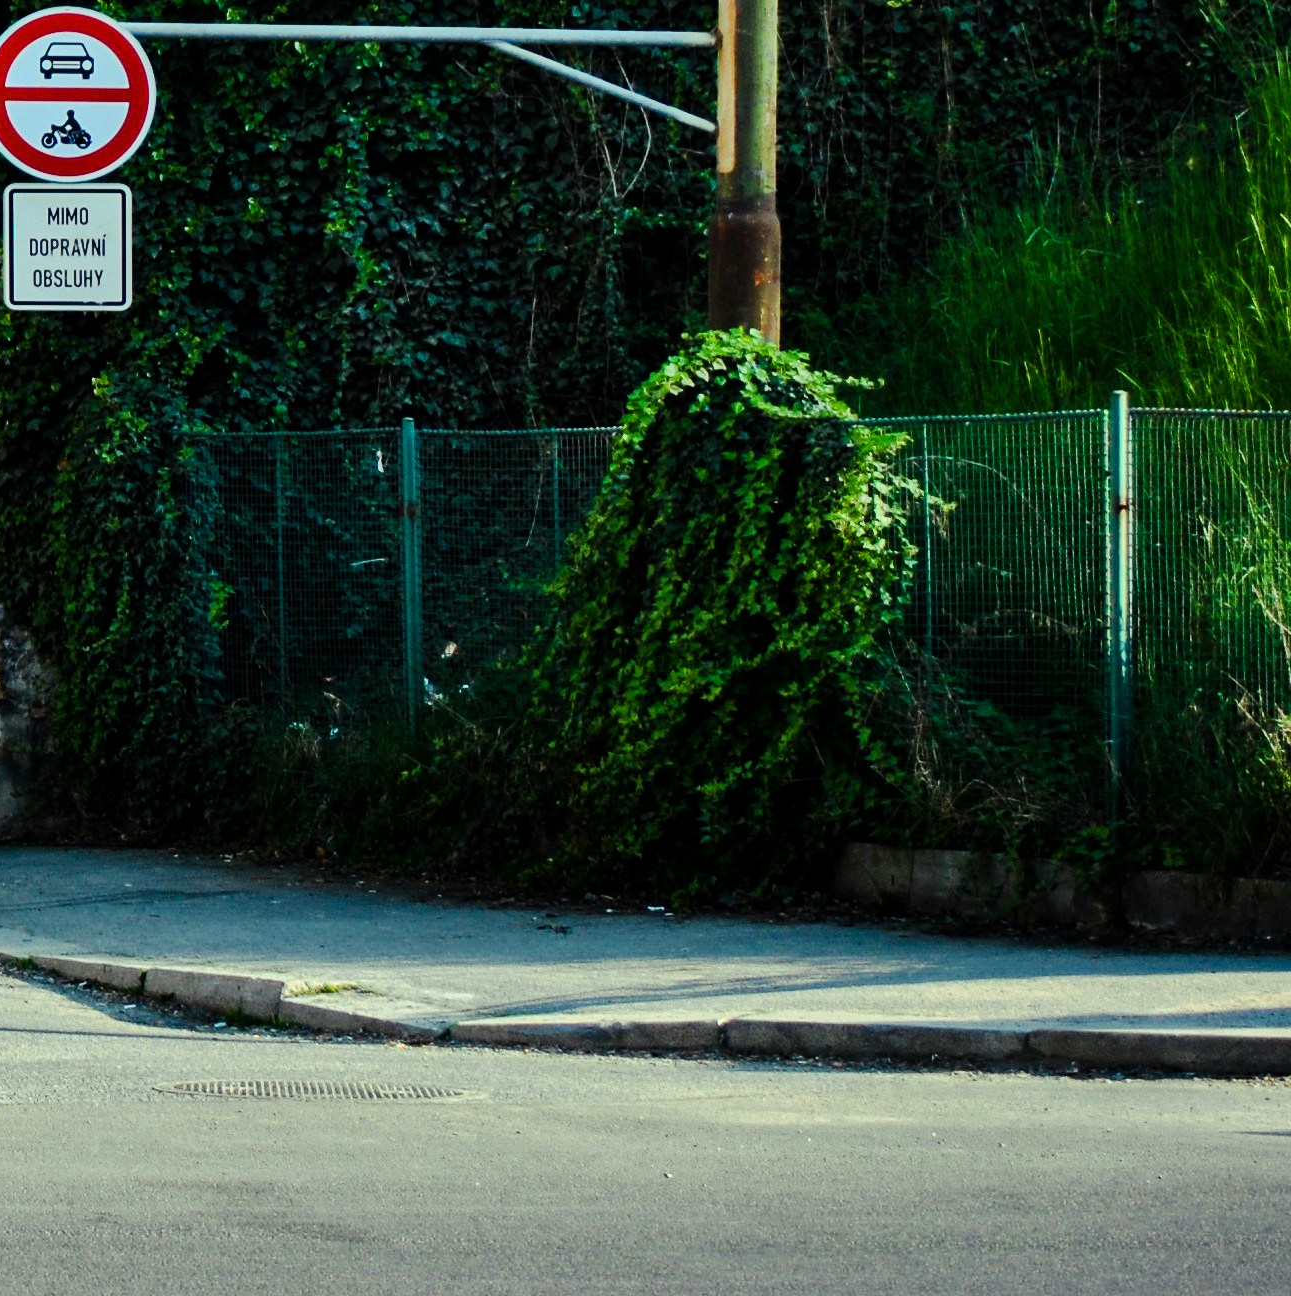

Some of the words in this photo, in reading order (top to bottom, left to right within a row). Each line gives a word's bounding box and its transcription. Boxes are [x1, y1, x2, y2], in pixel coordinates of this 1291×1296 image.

[47, 207, 89, 225] MIMO
[29, 234, 107, 257] DOPRAVNÍ
[33, 269, 103, 288] OBSLUHY
